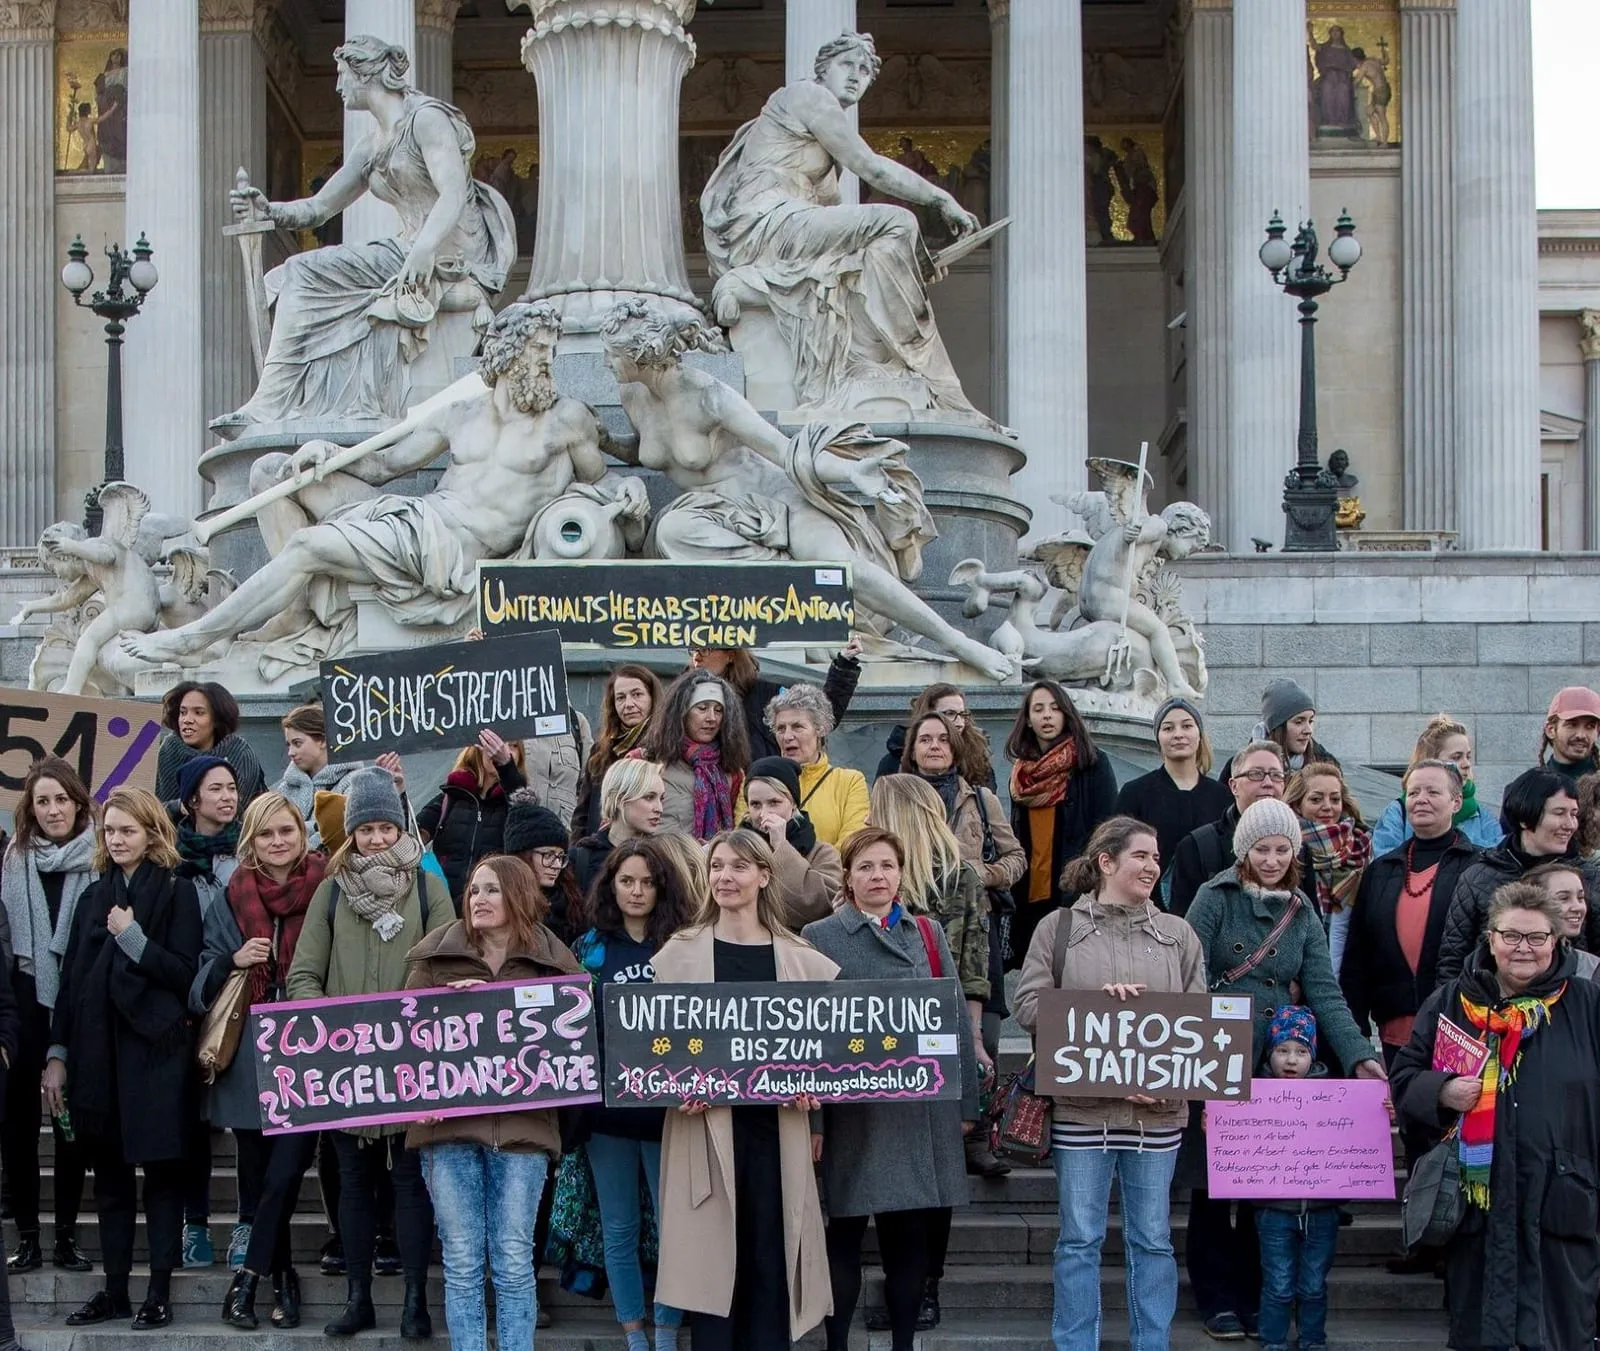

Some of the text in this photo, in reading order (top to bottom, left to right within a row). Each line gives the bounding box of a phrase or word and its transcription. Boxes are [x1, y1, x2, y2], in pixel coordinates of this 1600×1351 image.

[611, 622, 756, 647] STREICHEN
[437, 665, 556, 730] STREICHEN
[618, 994, 943, 1033] UNTERHALTSSICHERUNG
[730, 1037, 823, 1062] BIS ZUM
[753, 1066, 929, 1097] Ausbildungsabschluß
[1053, 1045, 1244, 1095] STATISTIK!
[1219, 1130, 1250, 1142] Frauen
[1264, 1130, 1296, 1141] Arbeit
[1284, 1160, 1301, 1173] auf
